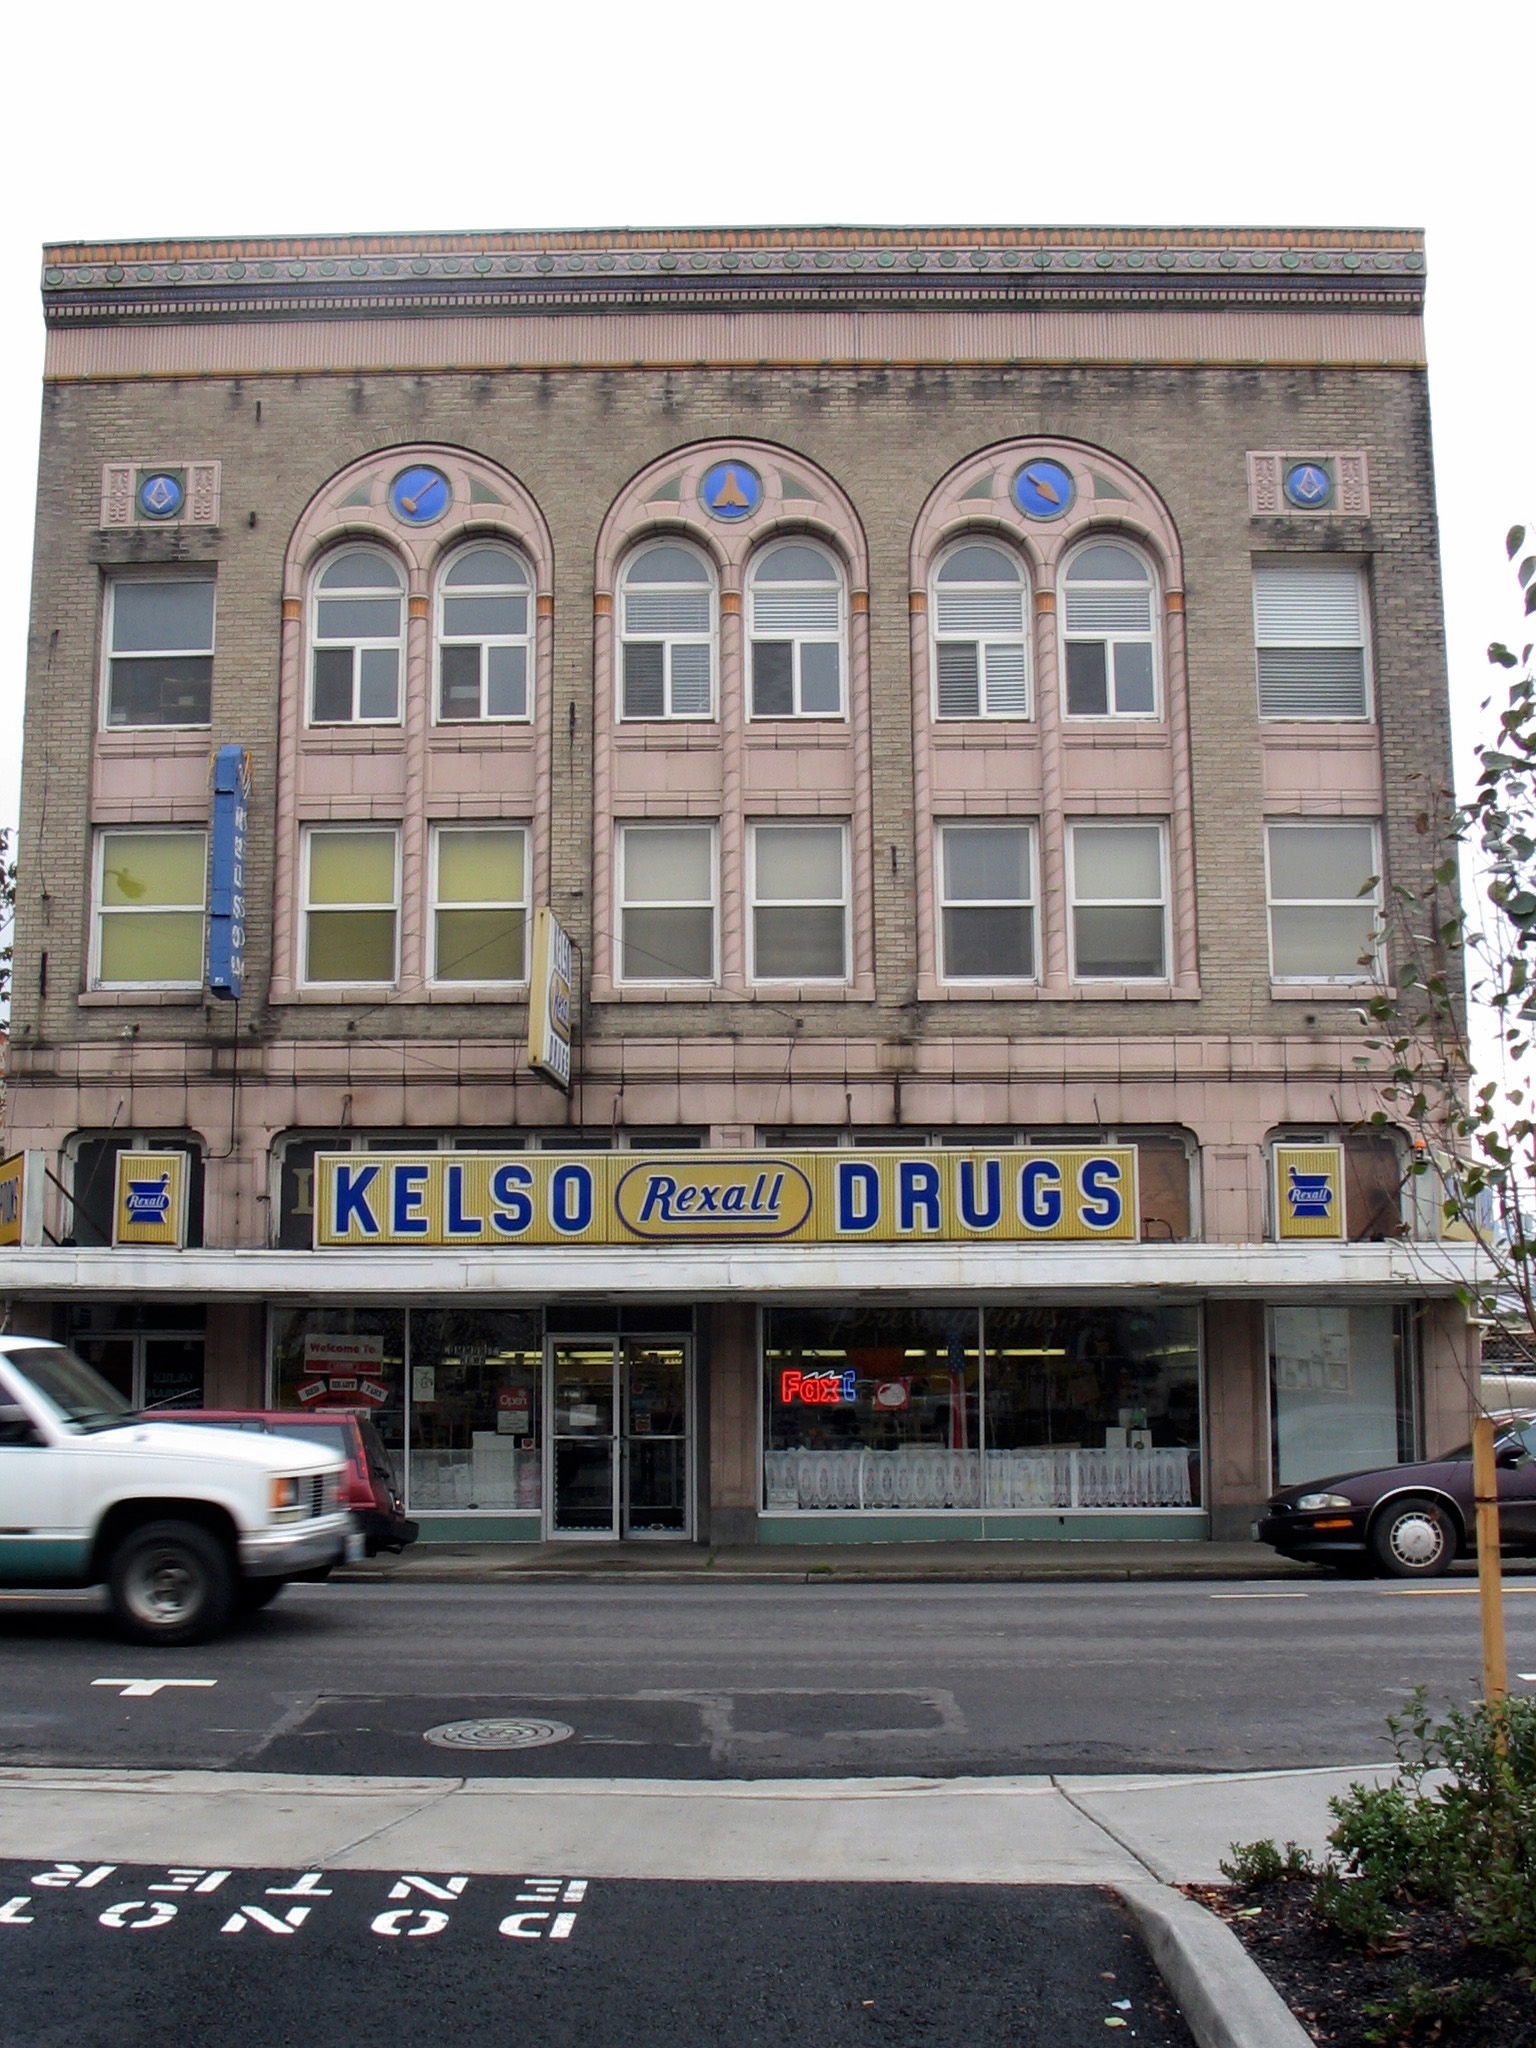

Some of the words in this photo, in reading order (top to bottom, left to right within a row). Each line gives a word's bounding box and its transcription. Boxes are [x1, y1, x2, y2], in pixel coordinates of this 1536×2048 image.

[128, 1194, 166, 1209] Rexall
[331, 1161, 594, 1237] KELSO
[637, 1172, 785, 1223] Rexall
[834, 1157, 1123, 1235] DRUGS
[1291, 1188, 1329, 1203] Rexall
[310, 1343, 360, 1354] Welcome
[363, 1344, 377, 1354] To
[782, 1371, 840, 1403] Fax
[500, 1395, 528, 1408] Open
[31, 1863, 588, 1902] ENTER
[370, 1909, 578, 1939] DO
